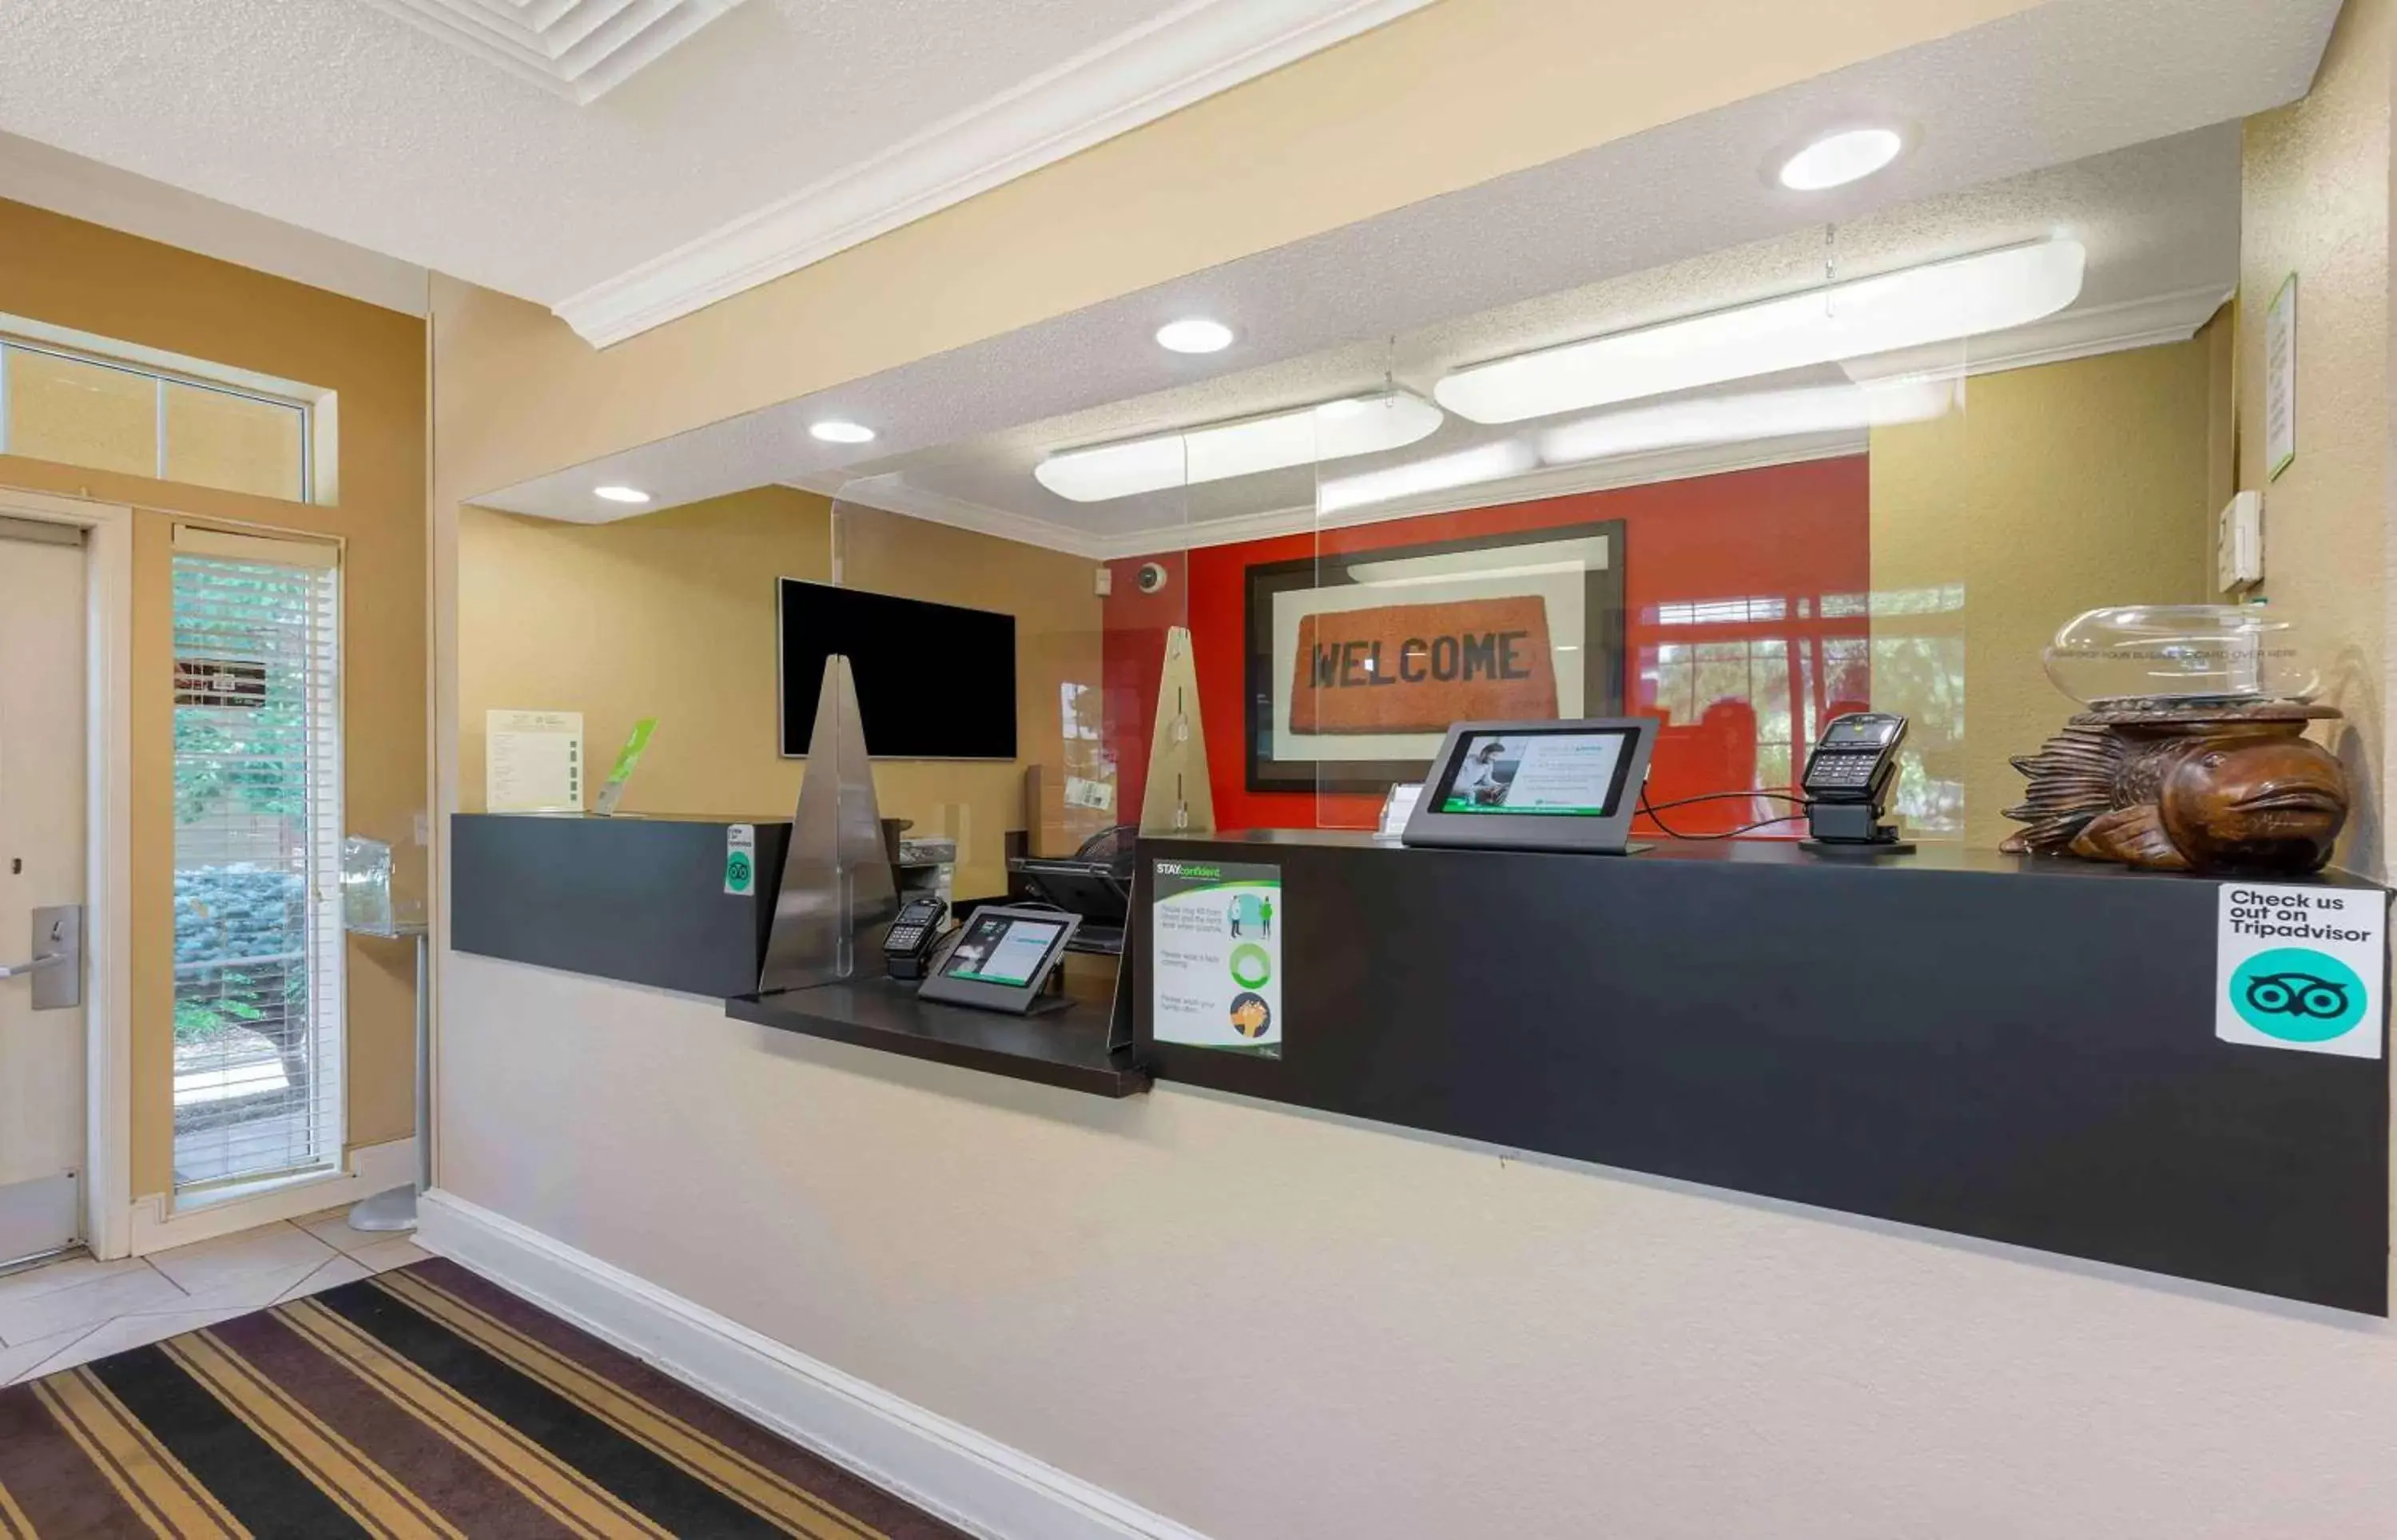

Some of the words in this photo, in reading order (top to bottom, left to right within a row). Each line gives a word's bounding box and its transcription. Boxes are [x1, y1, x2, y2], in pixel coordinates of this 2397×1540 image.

[1309, 630, 1531, 689] WELCOME
[2230, 890, 2311, 908] Check
[2316, 898, 2344, 910] us
[2230, 907, 2271, 919] out
[2276, 910, 2308, 922] on
[2229, 919, 2372, 942] Tripadvisor
